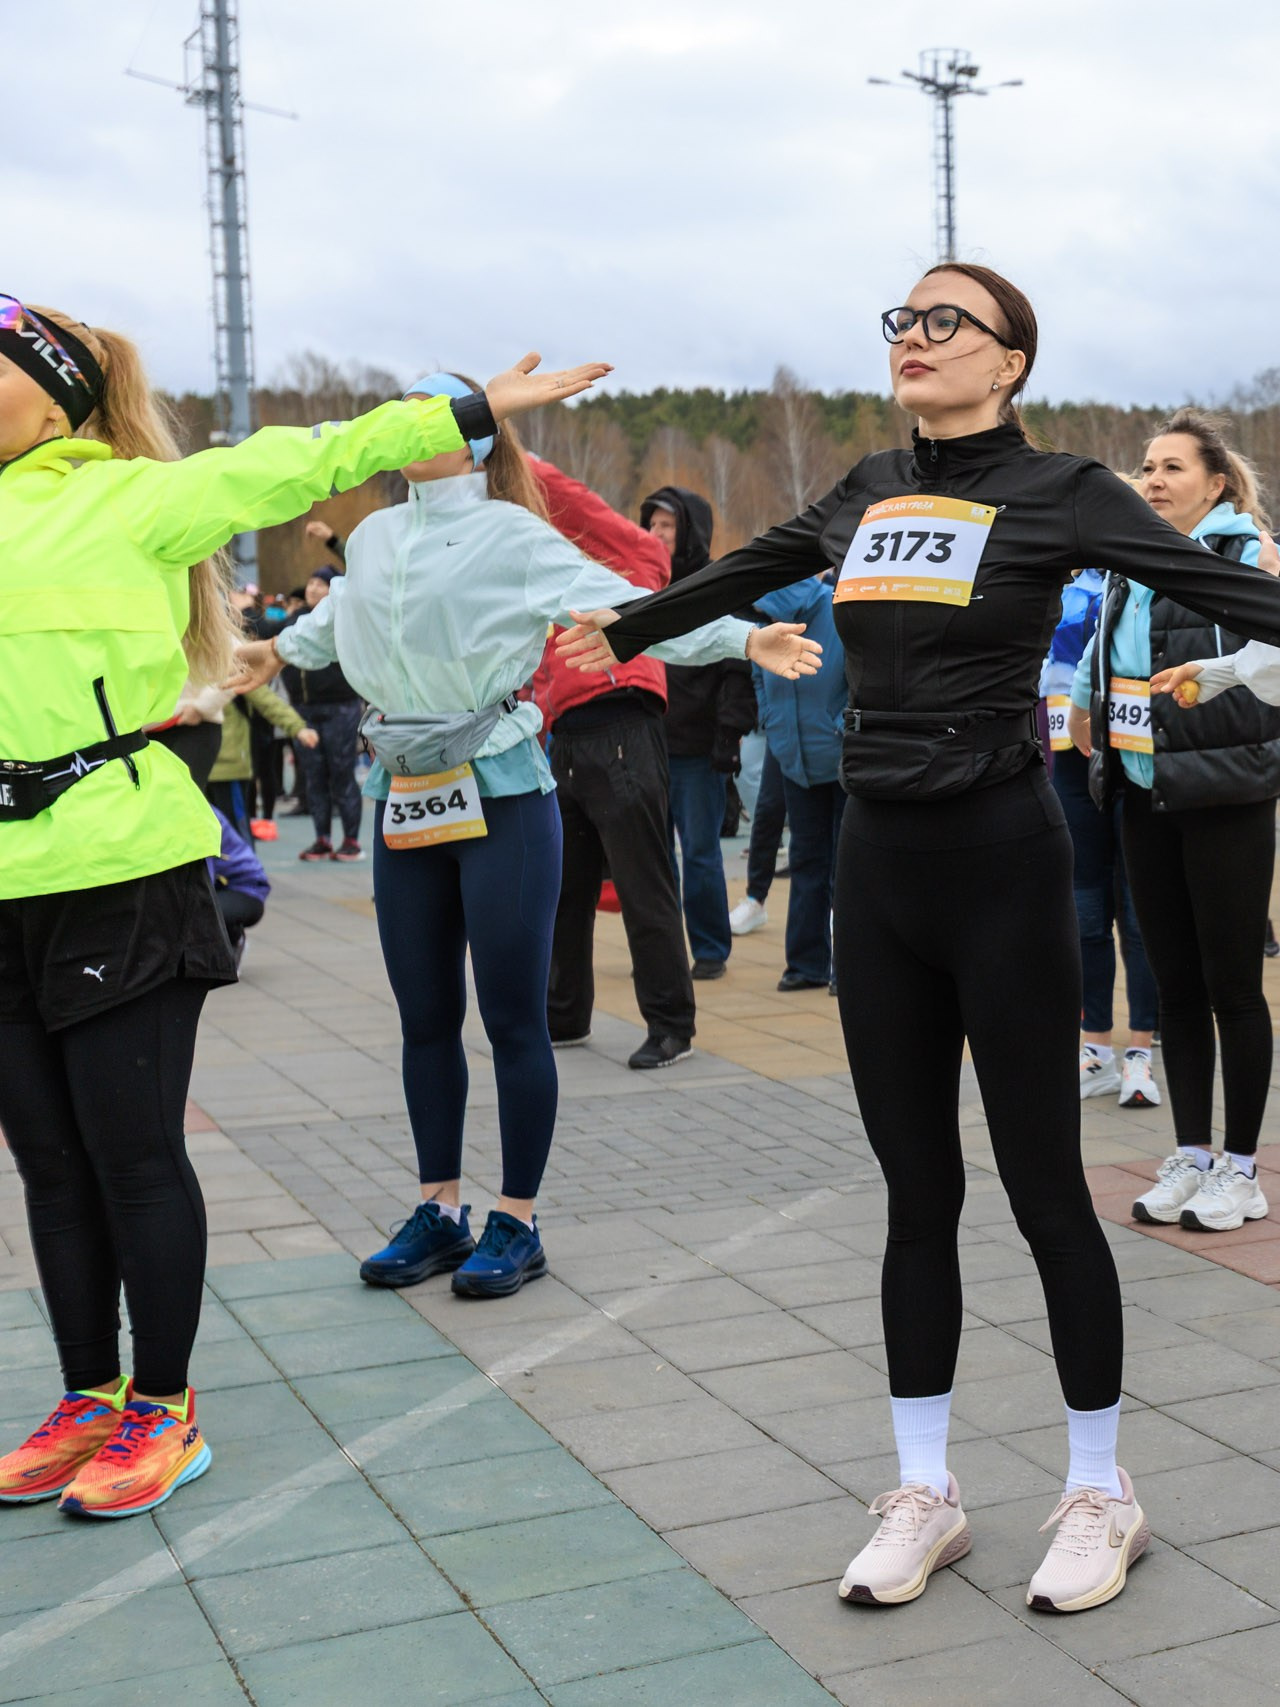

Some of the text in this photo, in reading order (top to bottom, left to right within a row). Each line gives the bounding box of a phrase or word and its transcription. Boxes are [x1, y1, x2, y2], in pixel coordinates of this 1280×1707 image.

[863, 530, 957, 564] 3173
[1048, 713, 1065, 731] 99
[390, 788, 468, 825] 3364
